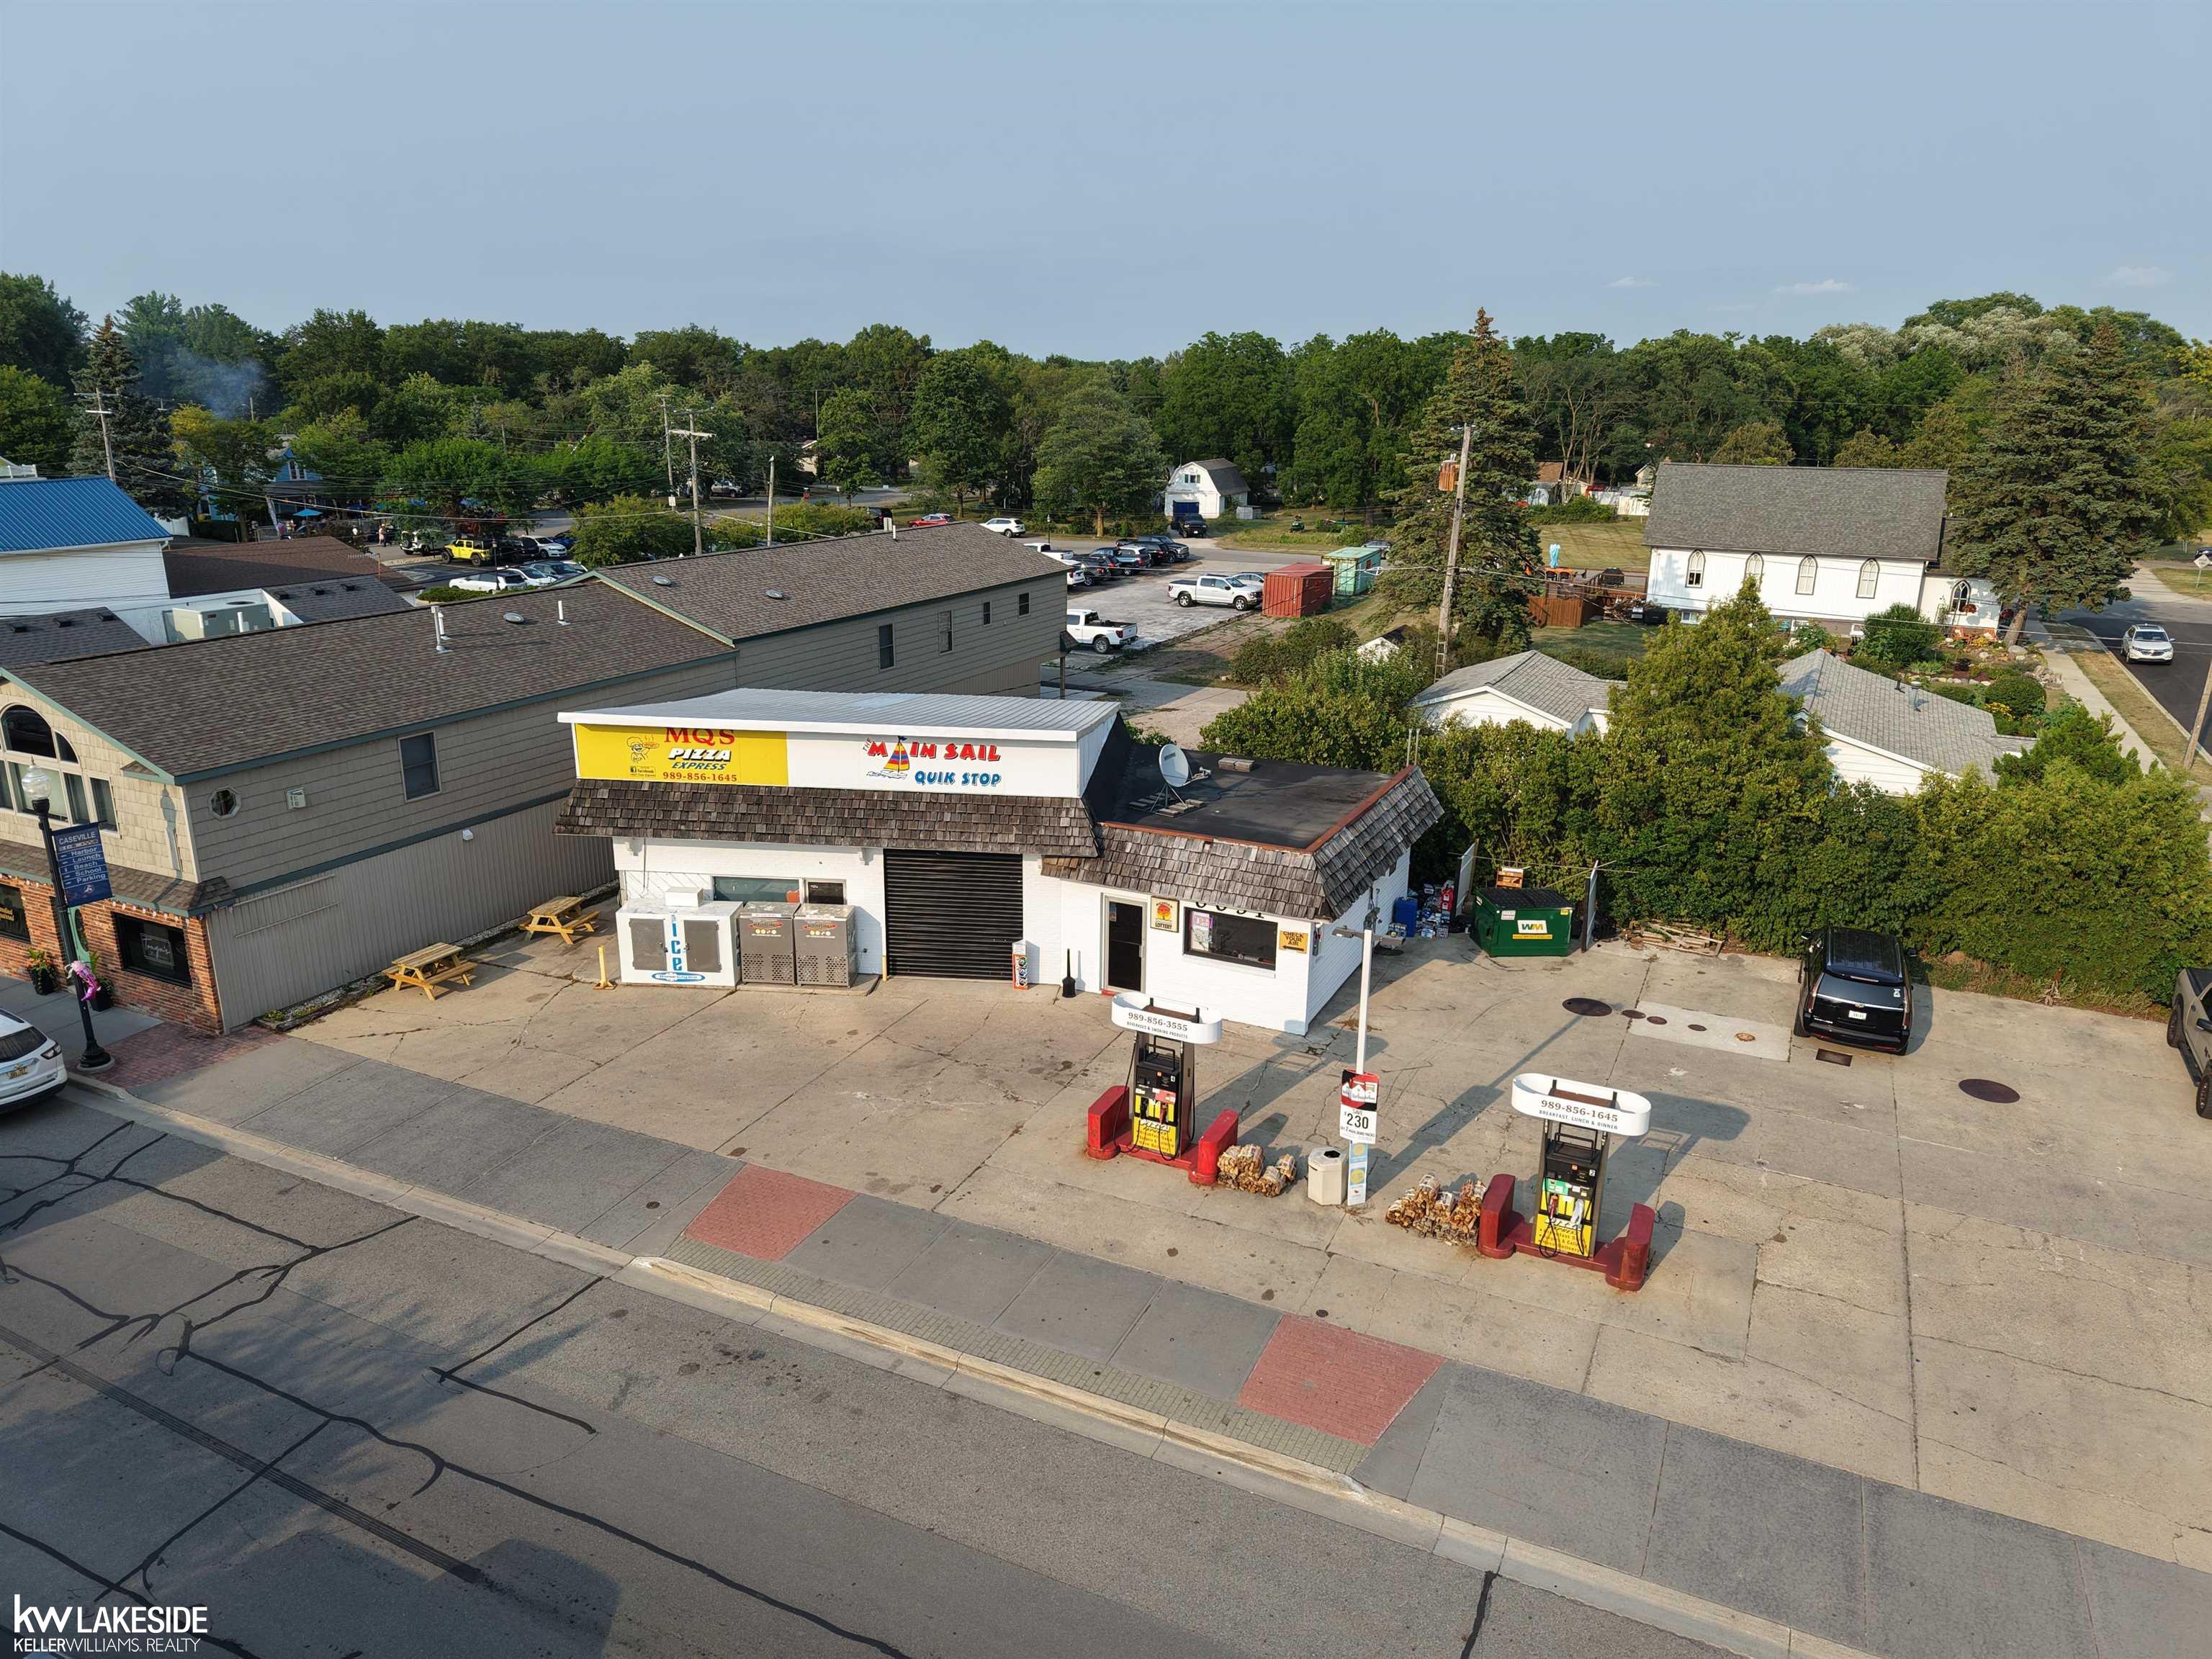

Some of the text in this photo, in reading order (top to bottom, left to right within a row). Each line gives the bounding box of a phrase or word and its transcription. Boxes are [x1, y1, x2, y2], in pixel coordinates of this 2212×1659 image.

[863, 737, 872, 752] THE
[943, 743, 1001, 761] SAIL
[668, 748, 732, 762] PIZZA
[672, 762, 727, 770] EXPRESS
[662, 771, 737, 782] 989-856-1645
[914, 770, 1002, 786] QUIK STOP
[59, 831, 96, 845] CASEVILLE
[71, 847, 97, 856] Harbor
[72, 853, 101, 863] Launch
[74, 861, 98, 870] Beach
[75, 867, 102, 876] School
[76, 873, 106, 883] Parking
[1128, 1012, 1188, 1031] 989-856-3555
[1541, 1100, 1618, 1122] 989-856-1645
